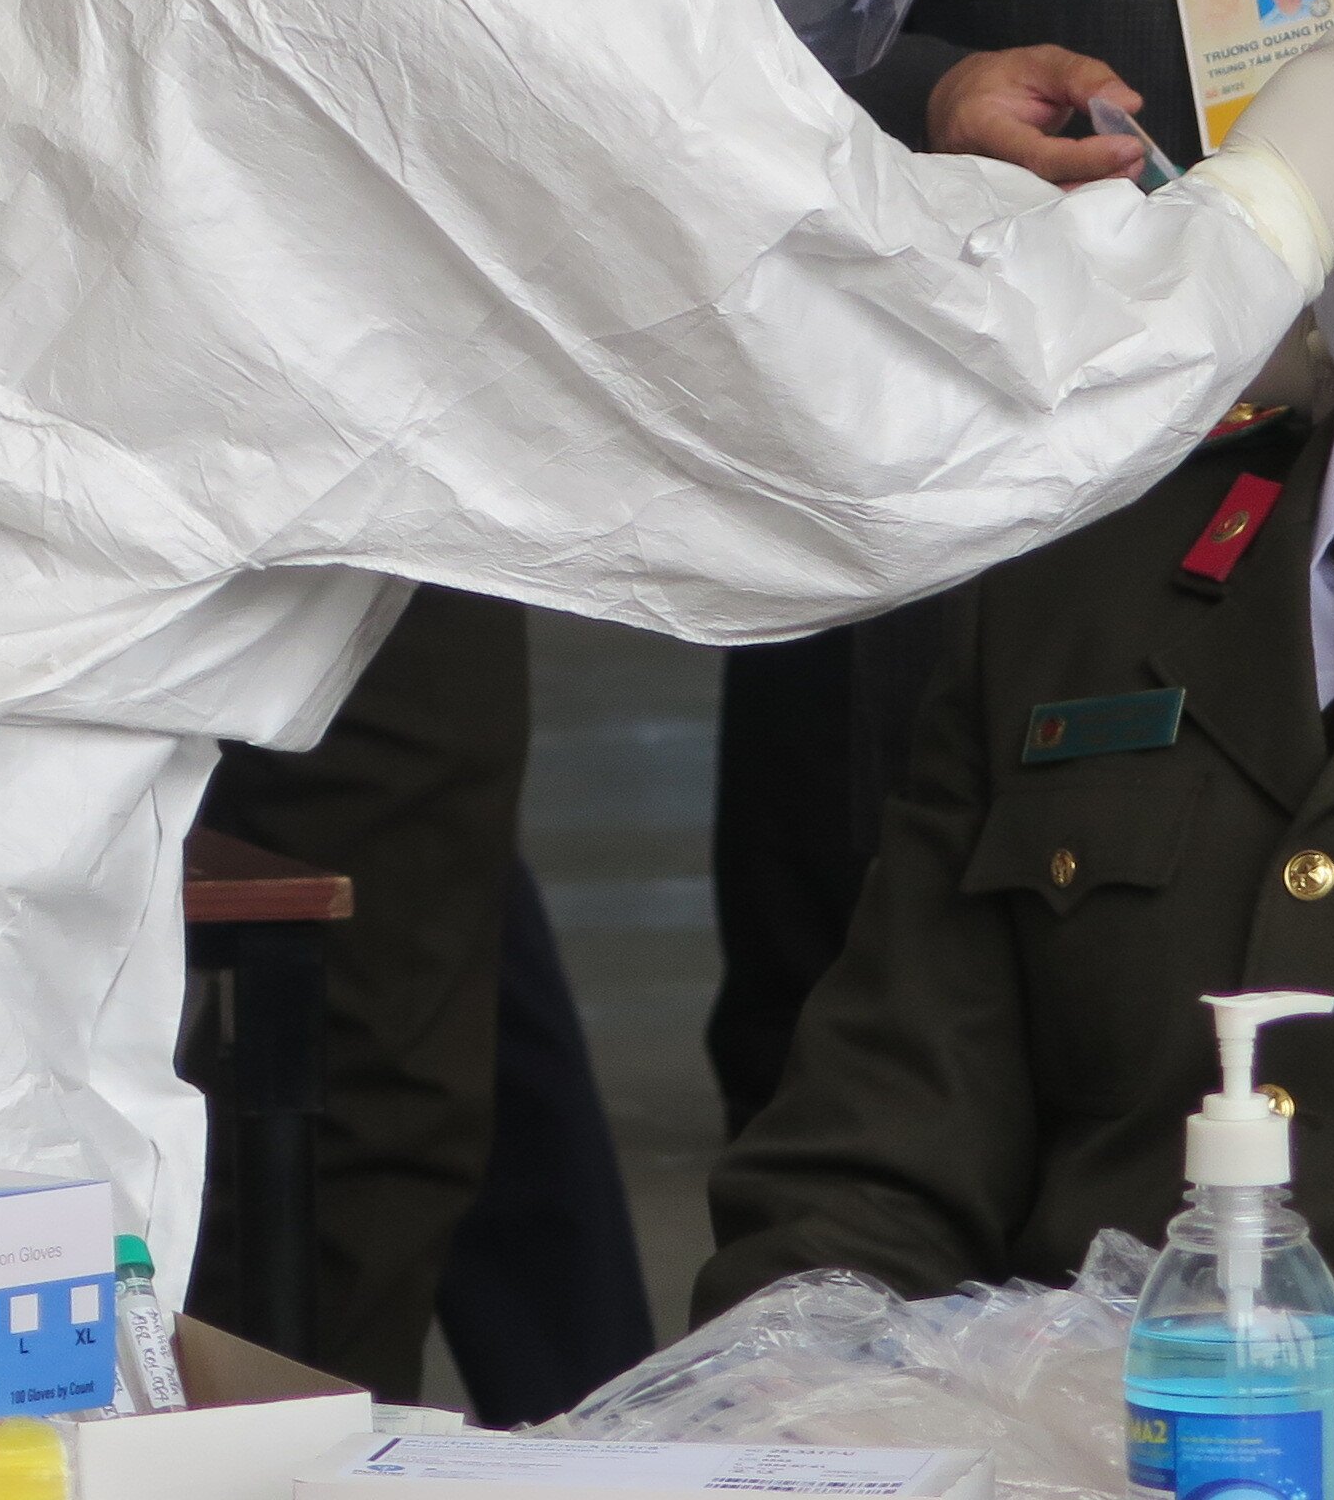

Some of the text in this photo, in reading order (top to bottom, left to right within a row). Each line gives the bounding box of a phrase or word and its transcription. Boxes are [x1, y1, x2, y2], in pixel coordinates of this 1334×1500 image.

[1263, 25, 1311, 47] QUANG
[20, 1243, 63, 1263] Gloves
[19, 1337, 30, 1355] L
[75, 1327, 97, 1347] XL
[10, 1380, 95, 1406] 100 Gloves by Count
